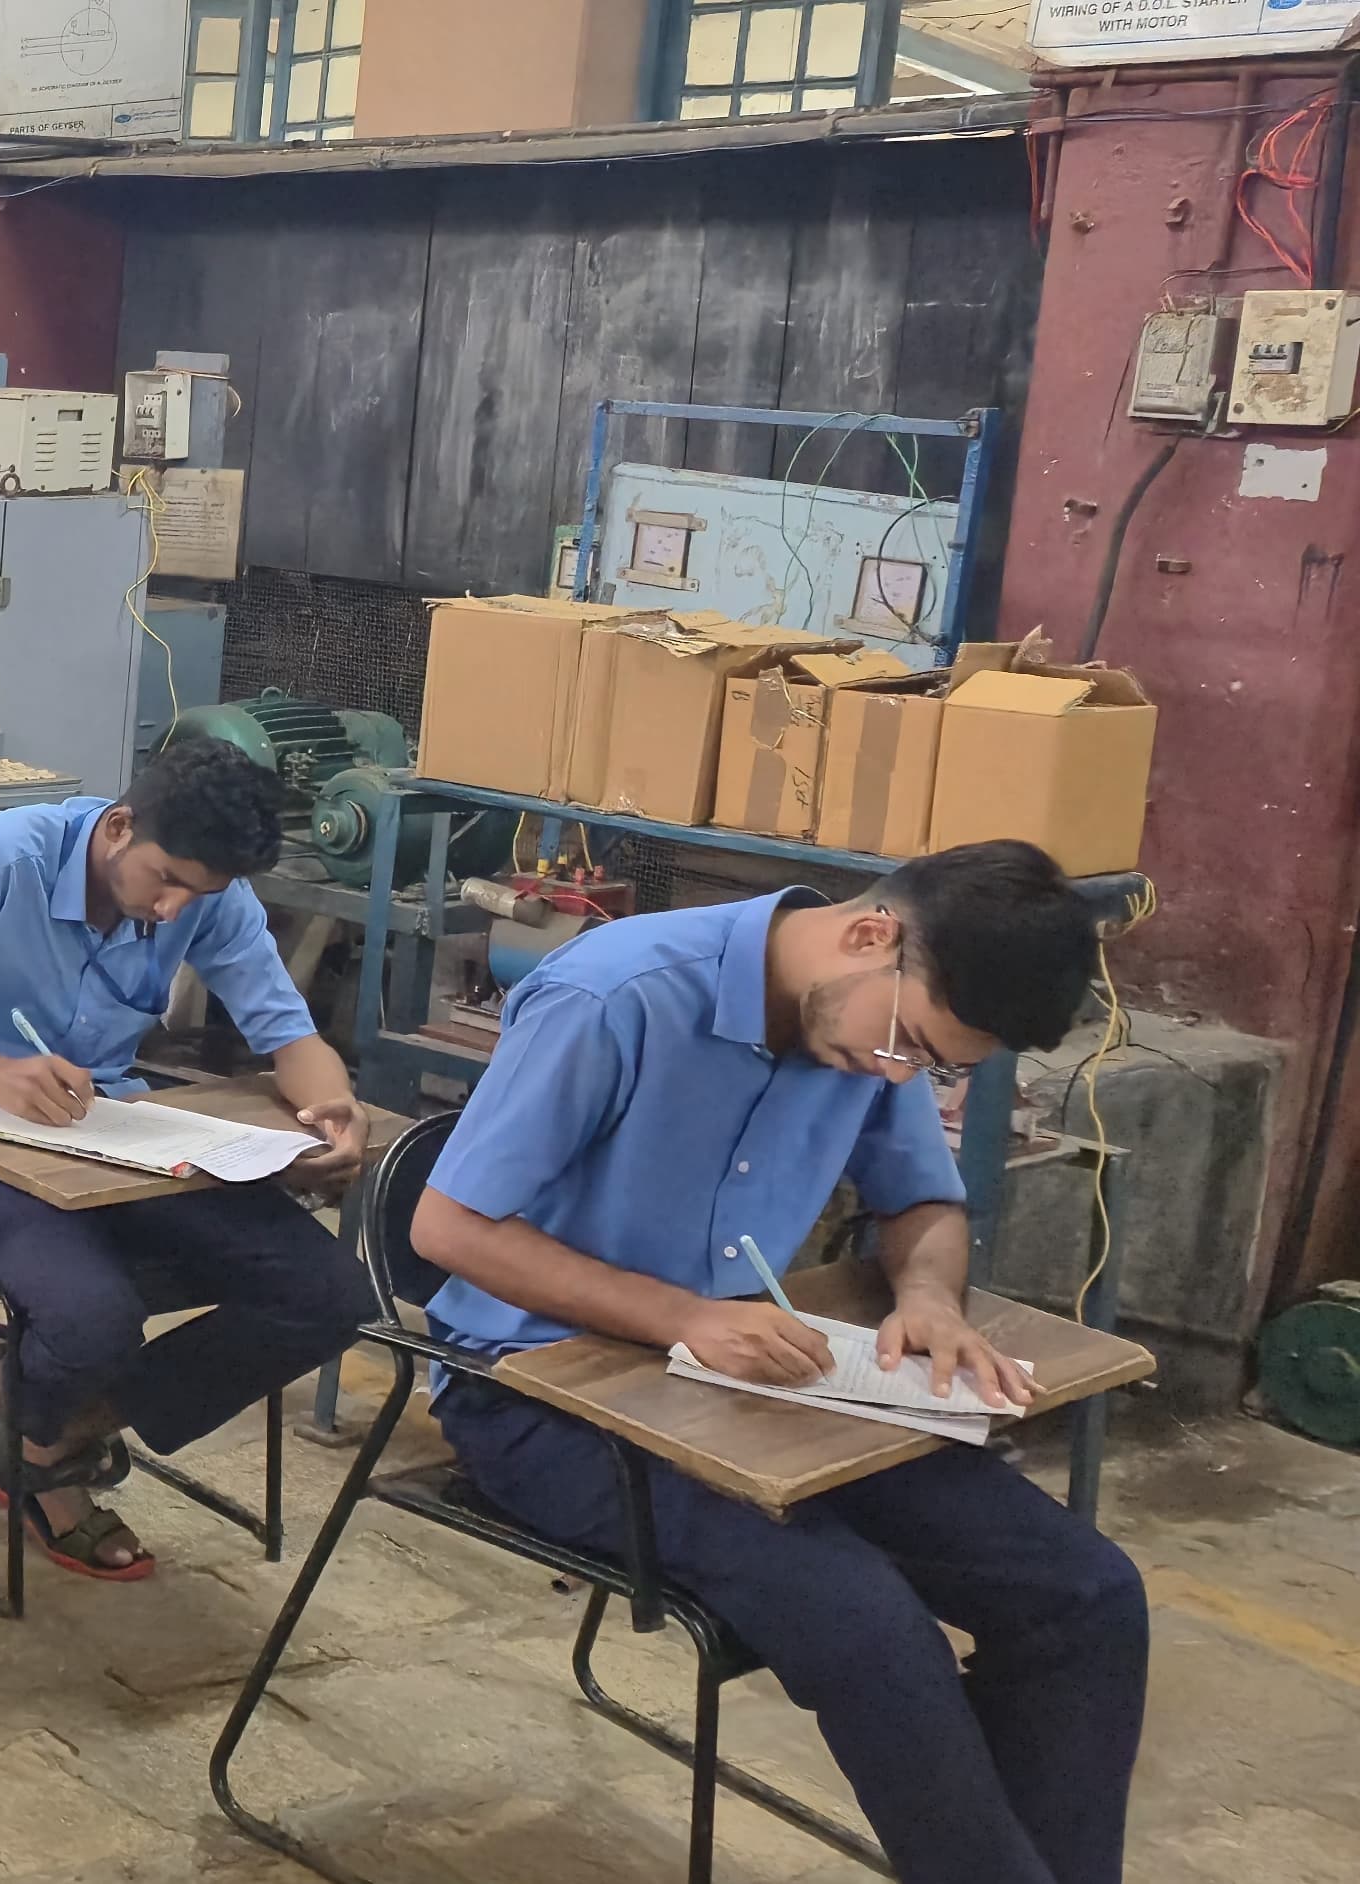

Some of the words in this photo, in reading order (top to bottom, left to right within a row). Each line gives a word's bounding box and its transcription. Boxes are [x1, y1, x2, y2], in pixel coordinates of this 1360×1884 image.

[1049, 3, 1098, 18] WIRING
[1101, 2, 1121, 15] OF
[1123, 1, 1135, 12] A
[1182, 0, 1247, 9] STAR
[1098, 18, 1133, 32] WITH
[1136, 15, 1189, 29] MOTOR
[9, 124, 35, 135] PARTS
[38, 123, 48, 132] OF
